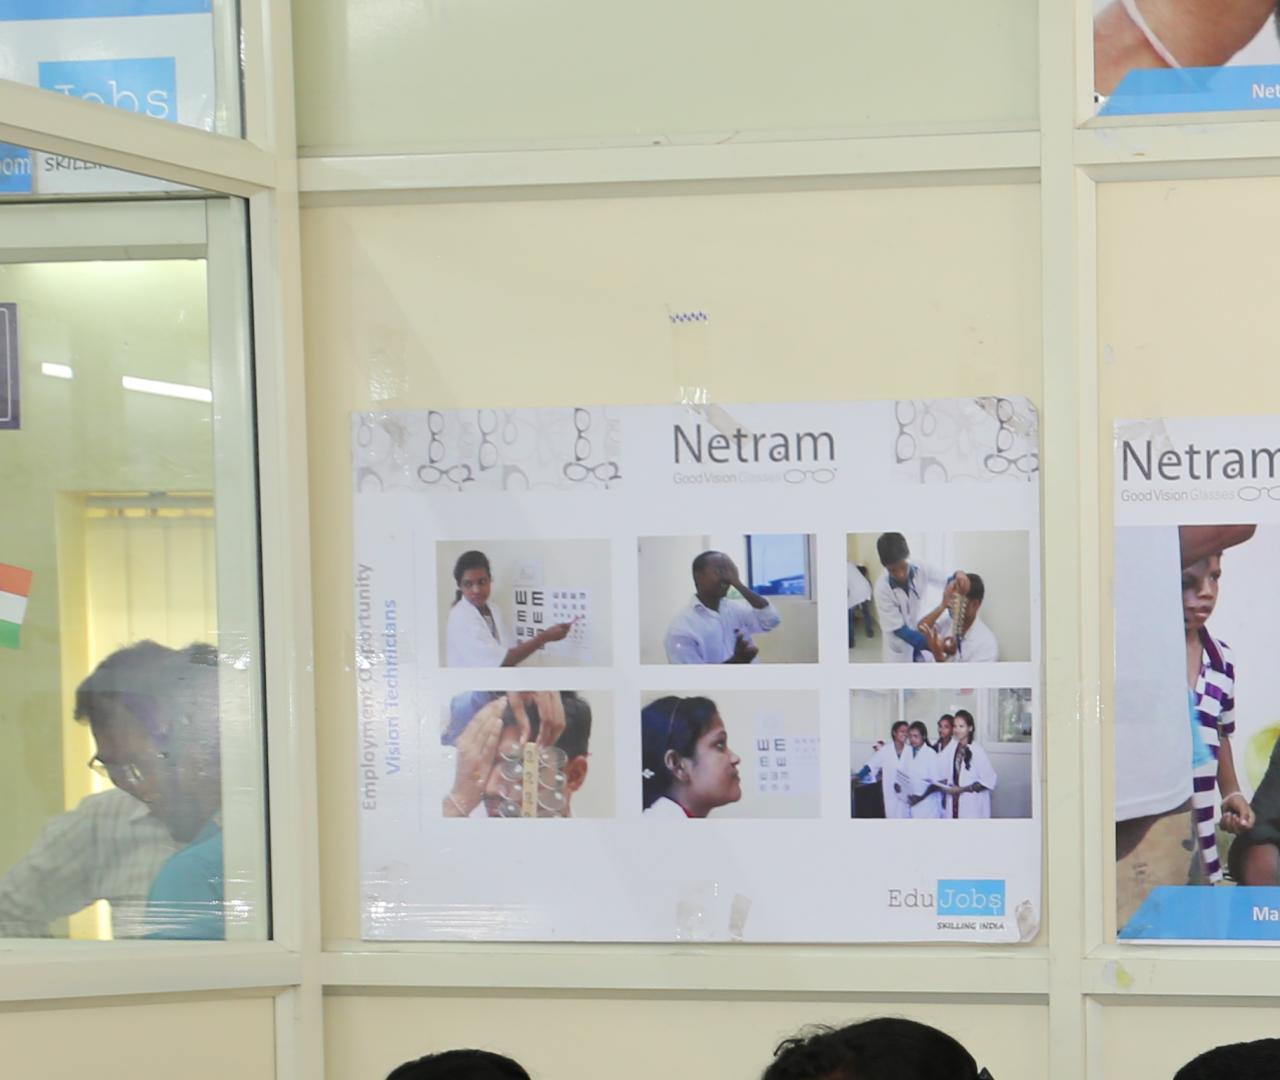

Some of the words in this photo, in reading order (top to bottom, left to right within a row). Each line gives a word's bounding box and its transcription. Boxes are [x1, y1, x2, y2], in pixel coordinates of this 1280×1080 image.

[54, 80, 169, 119] bs
[673, 424, 835, 464] Netram
[381, 600, 398, 707] Technicians
[360, 689, 379, 810] Employment
[385, 717, 400, 775] Vision
[937, 922, 977, 930] SKILLING
[979, 922, 1004, 930] INDIA
